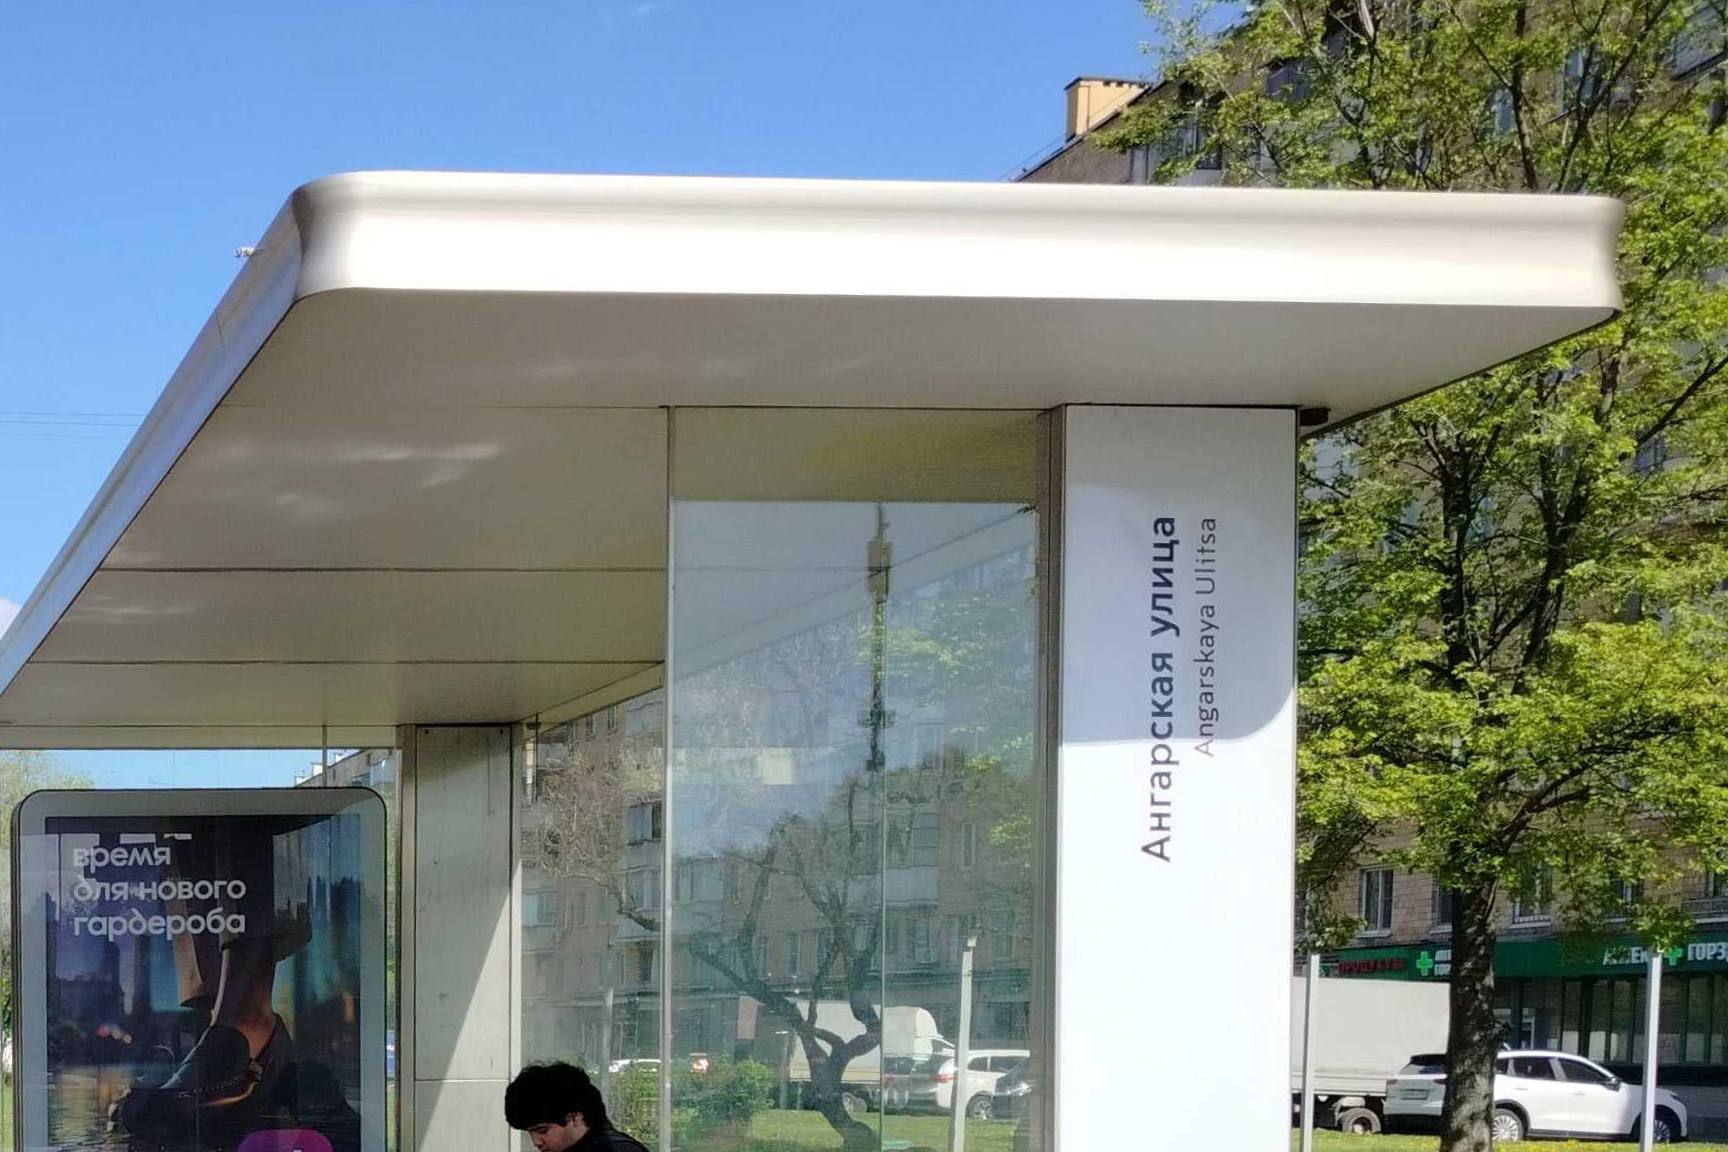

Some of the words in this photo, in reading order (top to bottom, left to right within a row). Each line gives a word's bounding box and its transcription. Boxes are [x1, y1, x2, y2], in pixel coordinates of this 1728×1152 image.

[1149, 516, 1180, 637] улица
[1194, 517, 1217, 595] Ulitsa
[1192, 604, 1220, 757] Angarskaya
[1140, 652, 1180, 862] Ангарская
[73, 847, 171, 874] время
[73, 875, 129, 902] для
[140, 879, 247, 901] нового
[74, 907, 247, 942] гардероба
[1687, 942, 1728, 962] ГОРЗ
